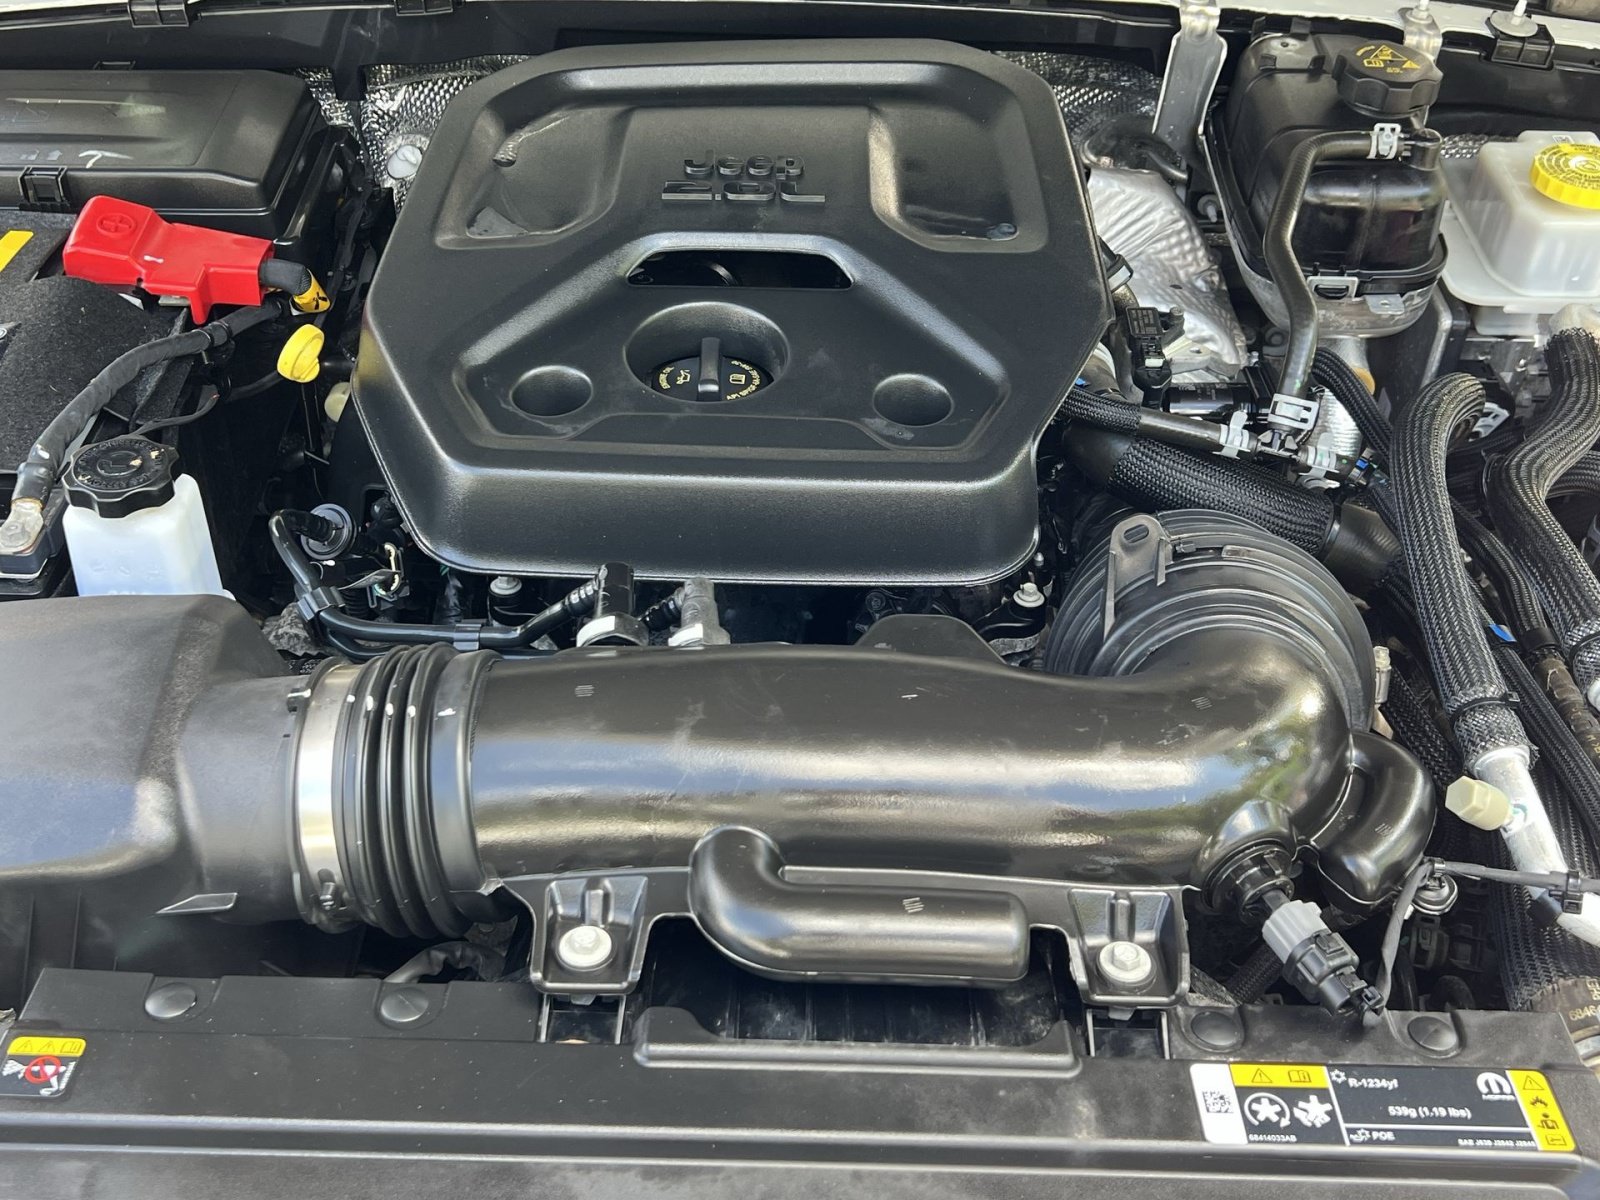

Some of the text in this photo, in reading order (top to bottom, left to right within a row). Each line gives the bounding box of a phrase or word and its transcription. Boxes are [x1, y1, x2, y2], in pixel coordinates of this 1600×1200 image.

[684, 149, 805, 180] Jeep
[661, 181, 826, 203] 2.0L
[1388, 1105, 1418, 1119] 539g
[1371, 1130, 1396, 1141] POE
